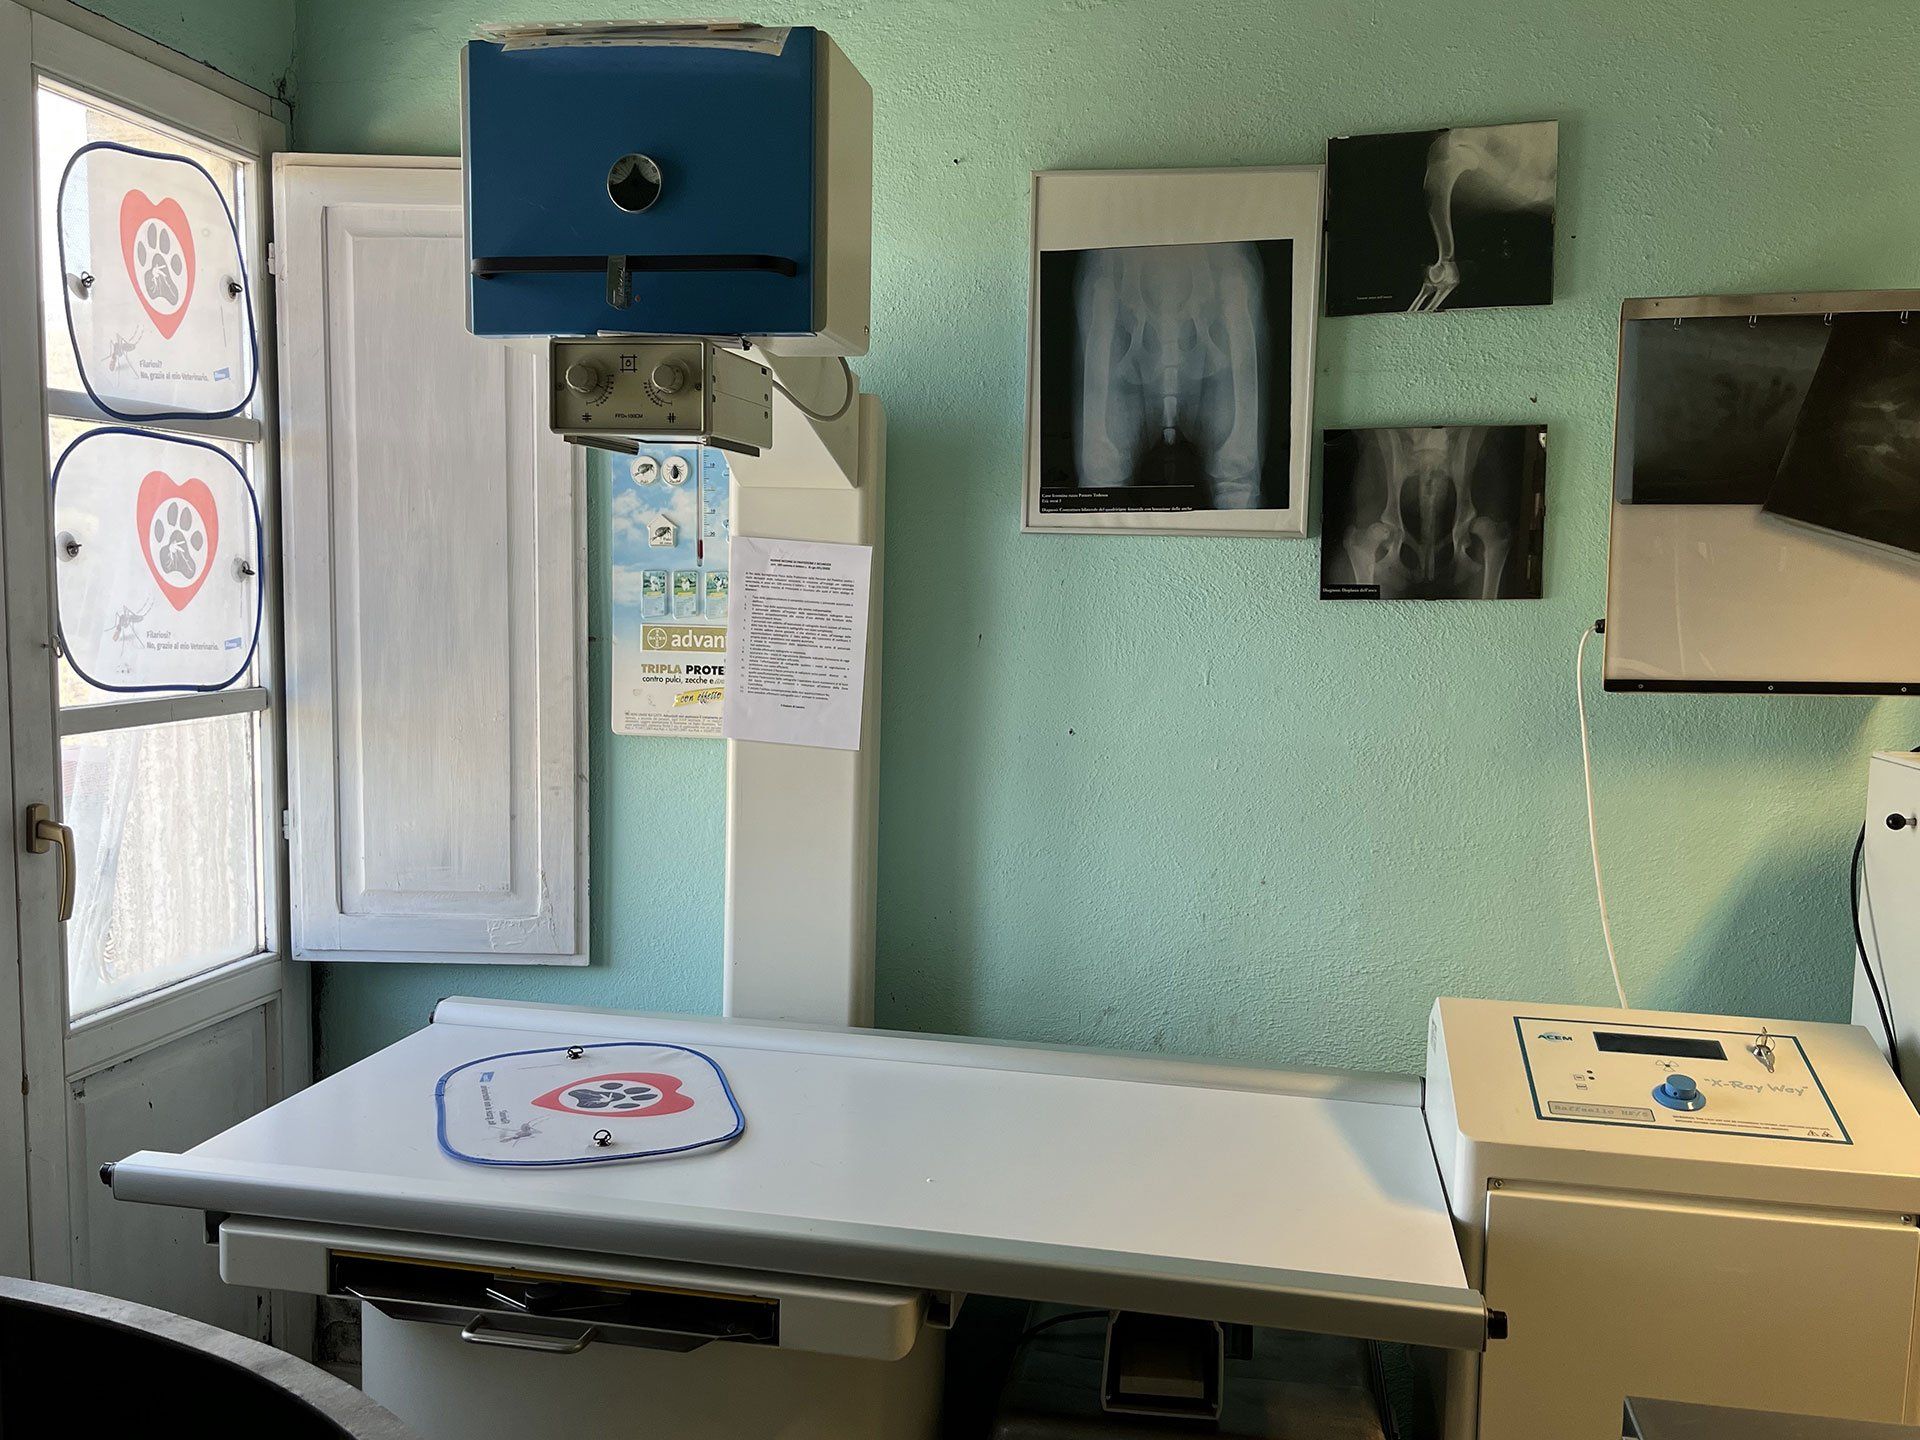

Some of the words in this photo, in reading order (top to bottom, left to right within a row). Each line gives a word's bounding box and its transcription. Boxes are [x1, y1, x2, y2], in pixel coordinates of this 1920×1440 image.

[149, 371, 165, 381] grazie
[146, 630, 171, 639] Filariosi?
[671, 629, 728, 648] advan
[146, 642, 156, 650] No,
[156, 642, 173, 651] grazie
[641, 663, 682, 674] TRIPLA
[642, 675, 664, 683] contro
[665, 676, 683, 685] pulci,
[685, 676, 708, 685] zecche
[680, 694, 694, 703] con
[1537, 1033, 1573, 1041] ACEM
